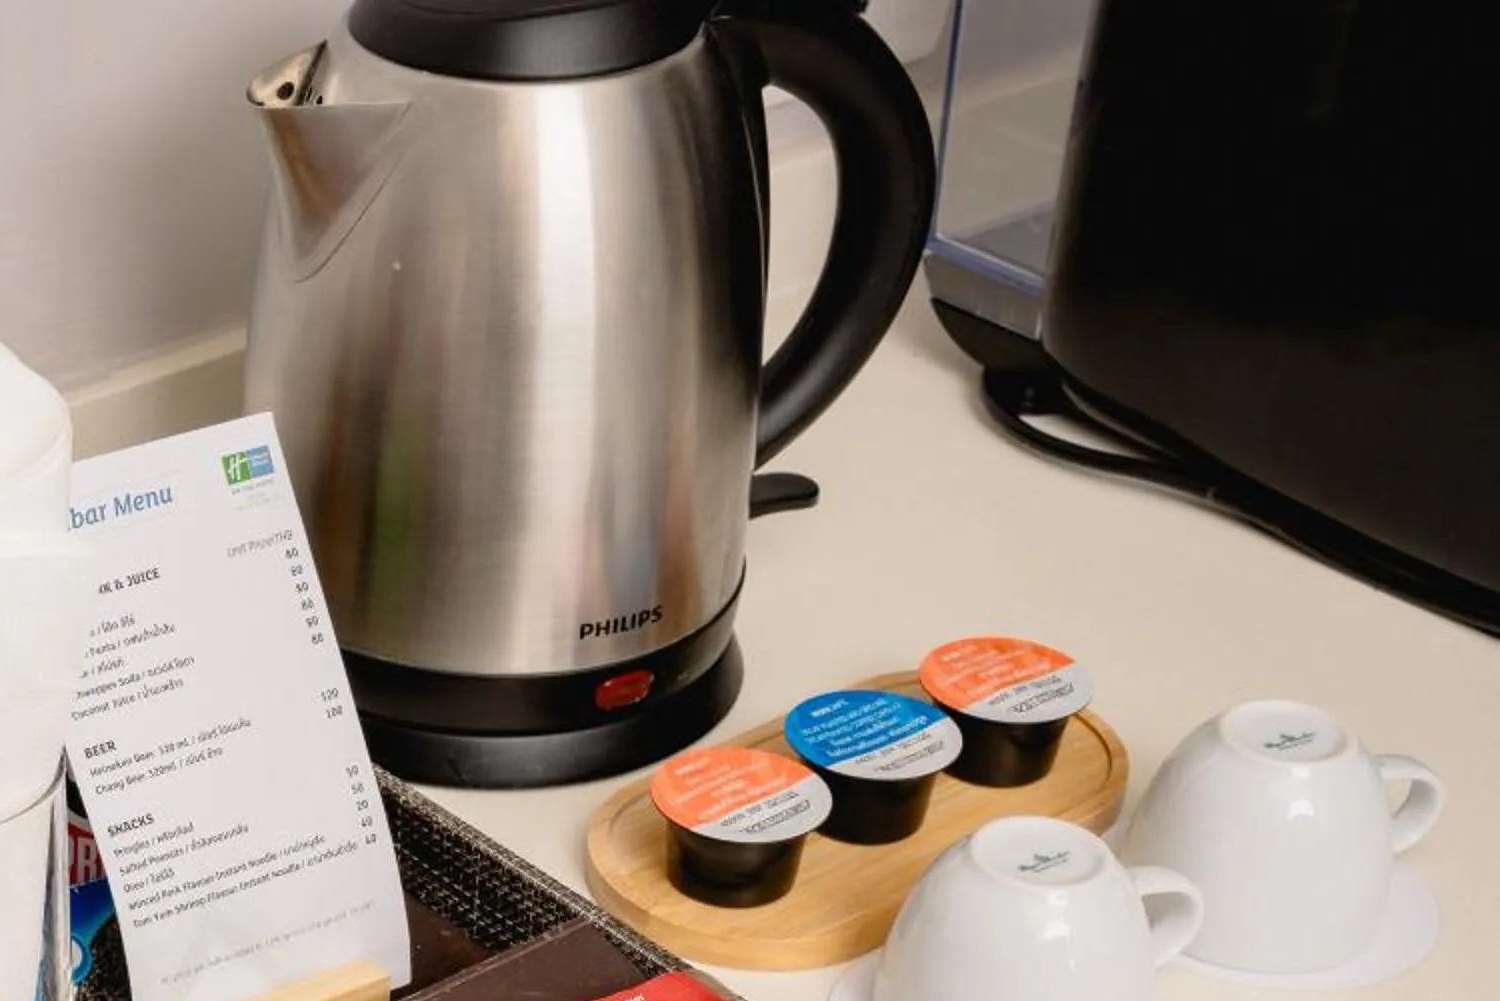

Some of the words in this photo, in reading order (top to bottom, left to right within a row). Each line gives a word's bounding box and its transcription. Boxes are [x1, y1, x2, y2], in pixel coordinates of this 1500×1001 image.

[68, 503, 106, 531] bar
[113, 487, 173, 517] Menu
[127, 567, 161, 588] JUICE
[579, 604, 664, 640] PHILIPS
[84, 739, 116, 759] BEER
[107, 812, 155, 838] SNACKS
